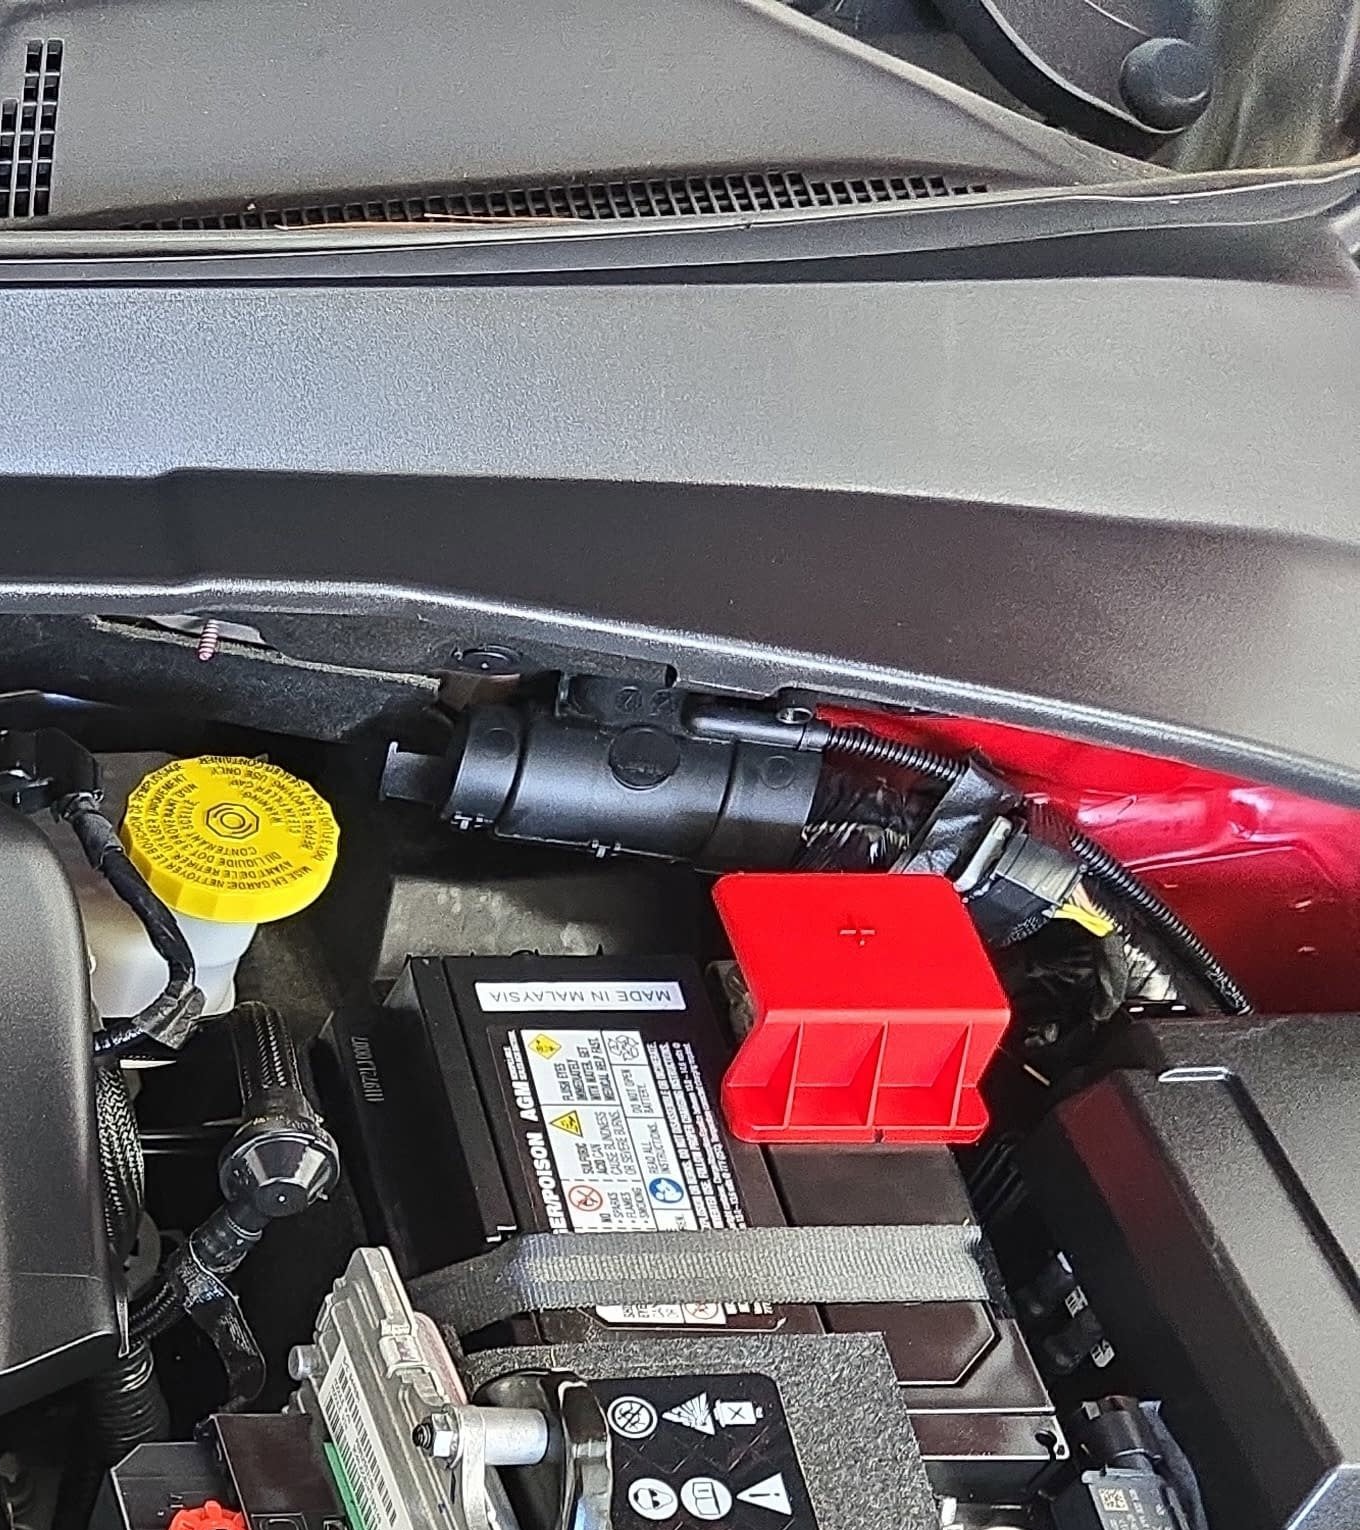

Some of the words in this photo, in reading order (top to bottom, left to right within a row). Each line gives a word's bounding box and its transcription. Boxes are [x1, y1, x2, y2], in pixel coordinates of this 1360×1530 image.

[488, 989, 586, 1003] MALAYSIA
[590, 989, 611, 1002] IN
[620, 989, 672, 1002] MADE
[511, 1081, 538, 1120] AGM
[605, 1151, 622, 1174] CAUSE
